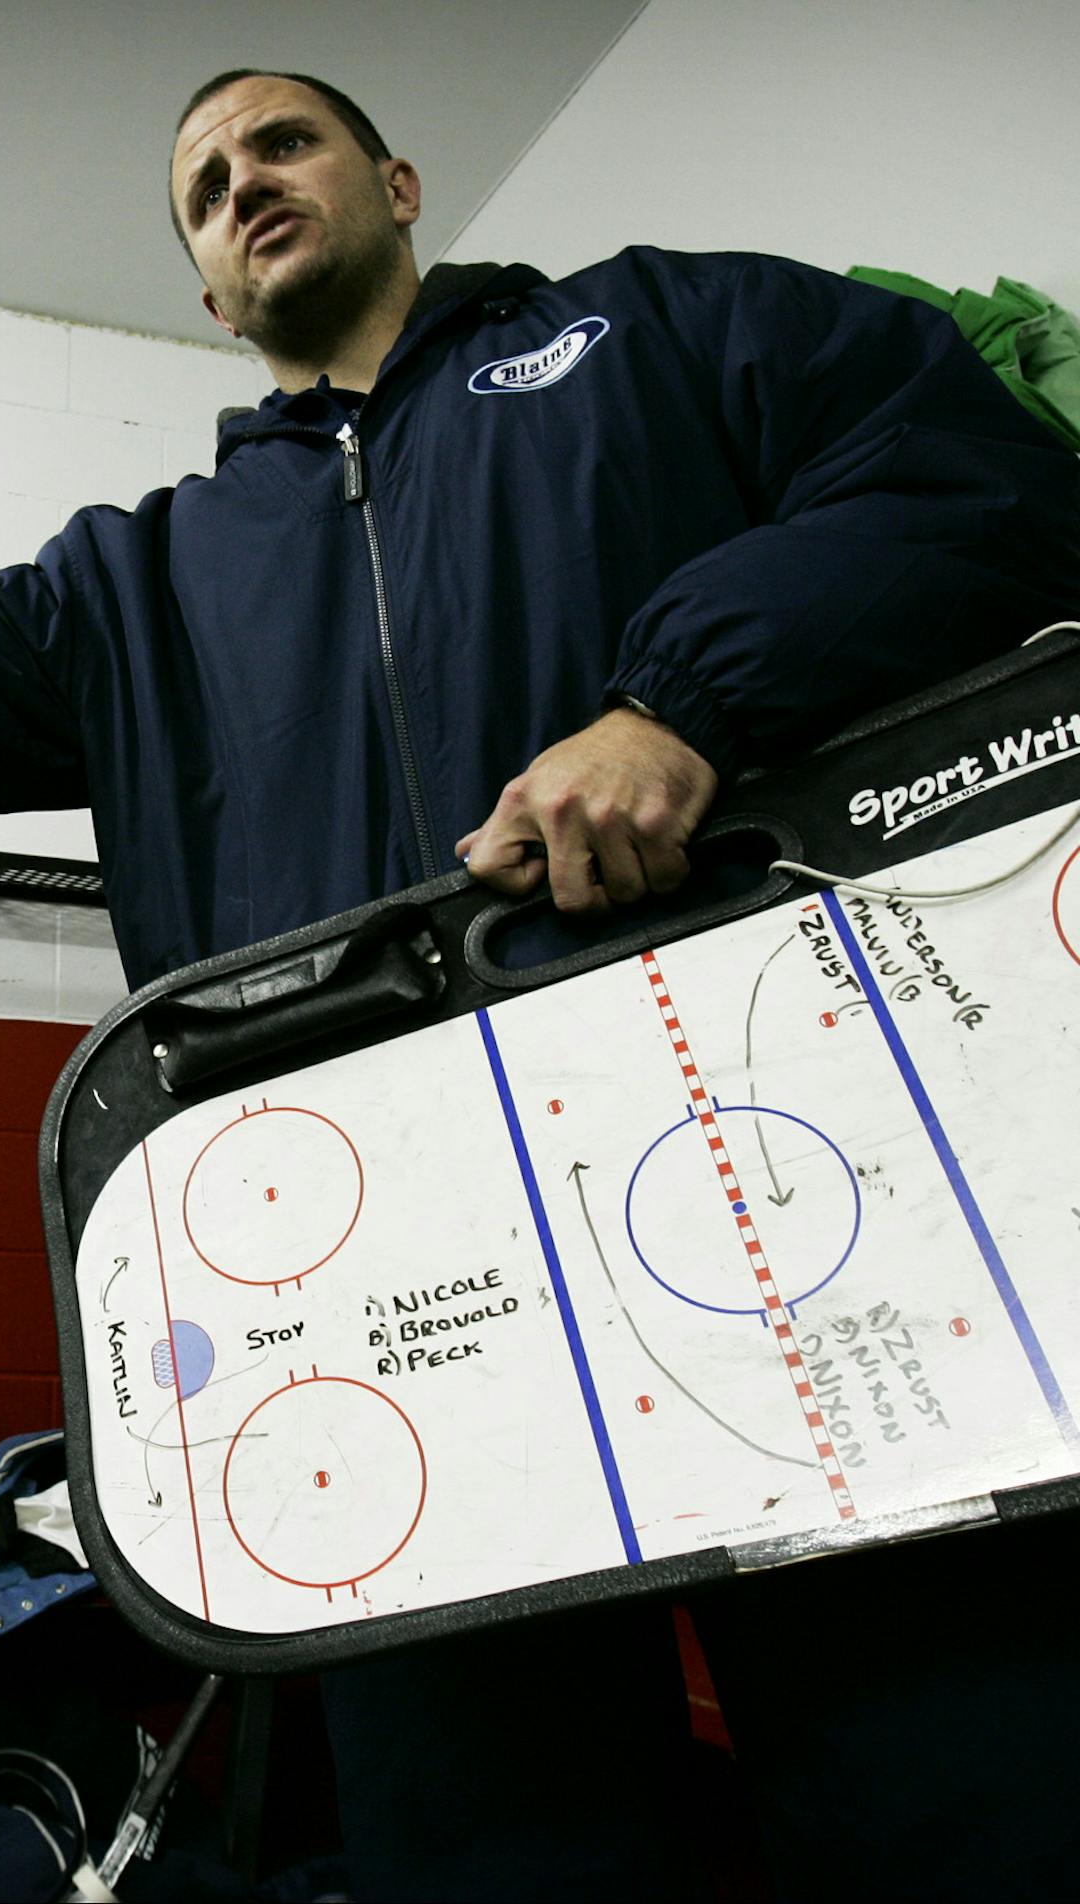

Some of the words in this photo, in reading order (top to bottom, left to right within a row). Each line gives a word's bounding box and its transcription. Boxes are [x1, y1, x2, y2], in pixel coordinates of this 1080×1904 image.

[500, 337, 573, 382] Blaine
[848, 756, 983, 828] Sport
[913, 803, 943, 821] Made
[961, 784, 986, 797] USA
[799, 913, 861, 993] ZRUST
[392, 1268, 503, 1317] NICOLE
[399, 1297, 519, 1343] BROVOLD
[107, 1320, 138, 1419] KAITLIN
[407, 1341, 483, 1373] PECK
[880, 1327, 951, 1430] ZRUST
[808, 1358, 867, 1468] NIXON
[848, 1345, 907, 1443] NIXON
